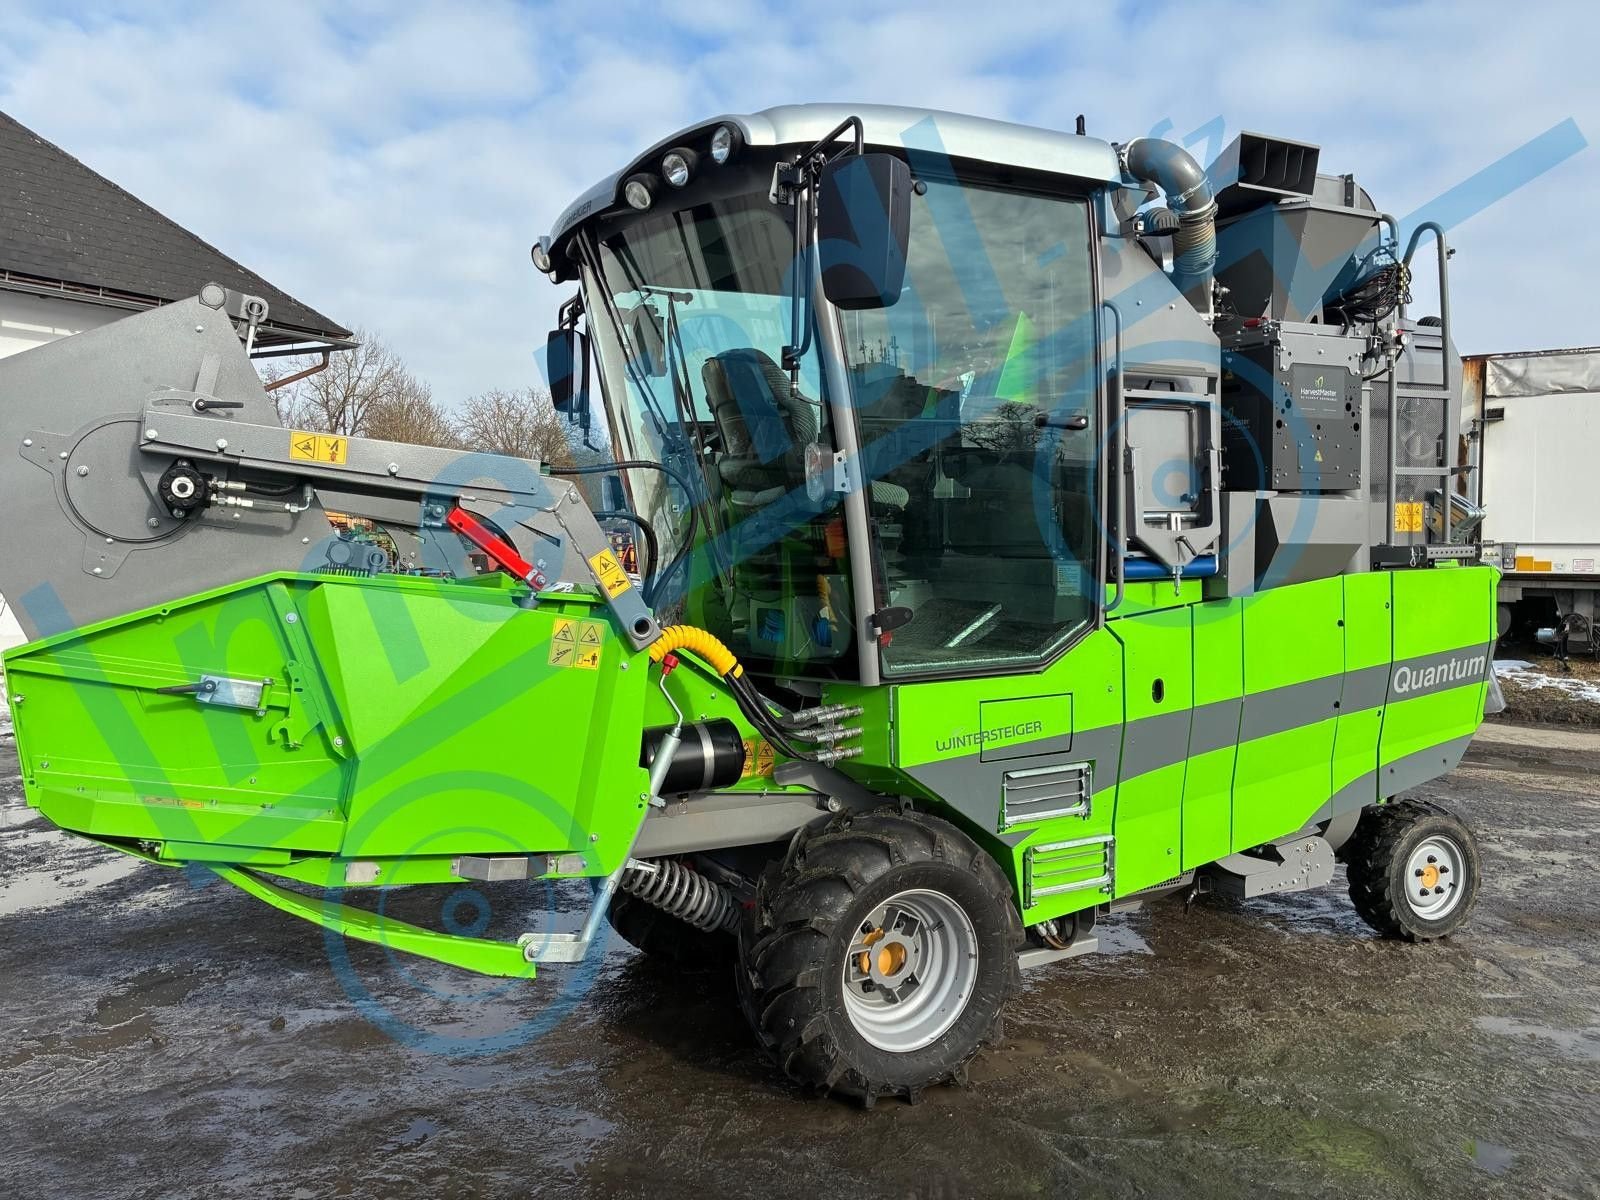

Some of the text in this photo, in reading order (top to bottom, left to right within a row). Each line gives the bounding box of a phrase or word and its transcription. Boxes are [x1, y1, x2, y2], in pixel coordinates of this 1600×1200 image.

[1300, 387, 1337, 397] HarvestMaster
[1393, 655, 1485, 693] Quantum
[936, 720, 1042, 752] WINTERSTEIGER
